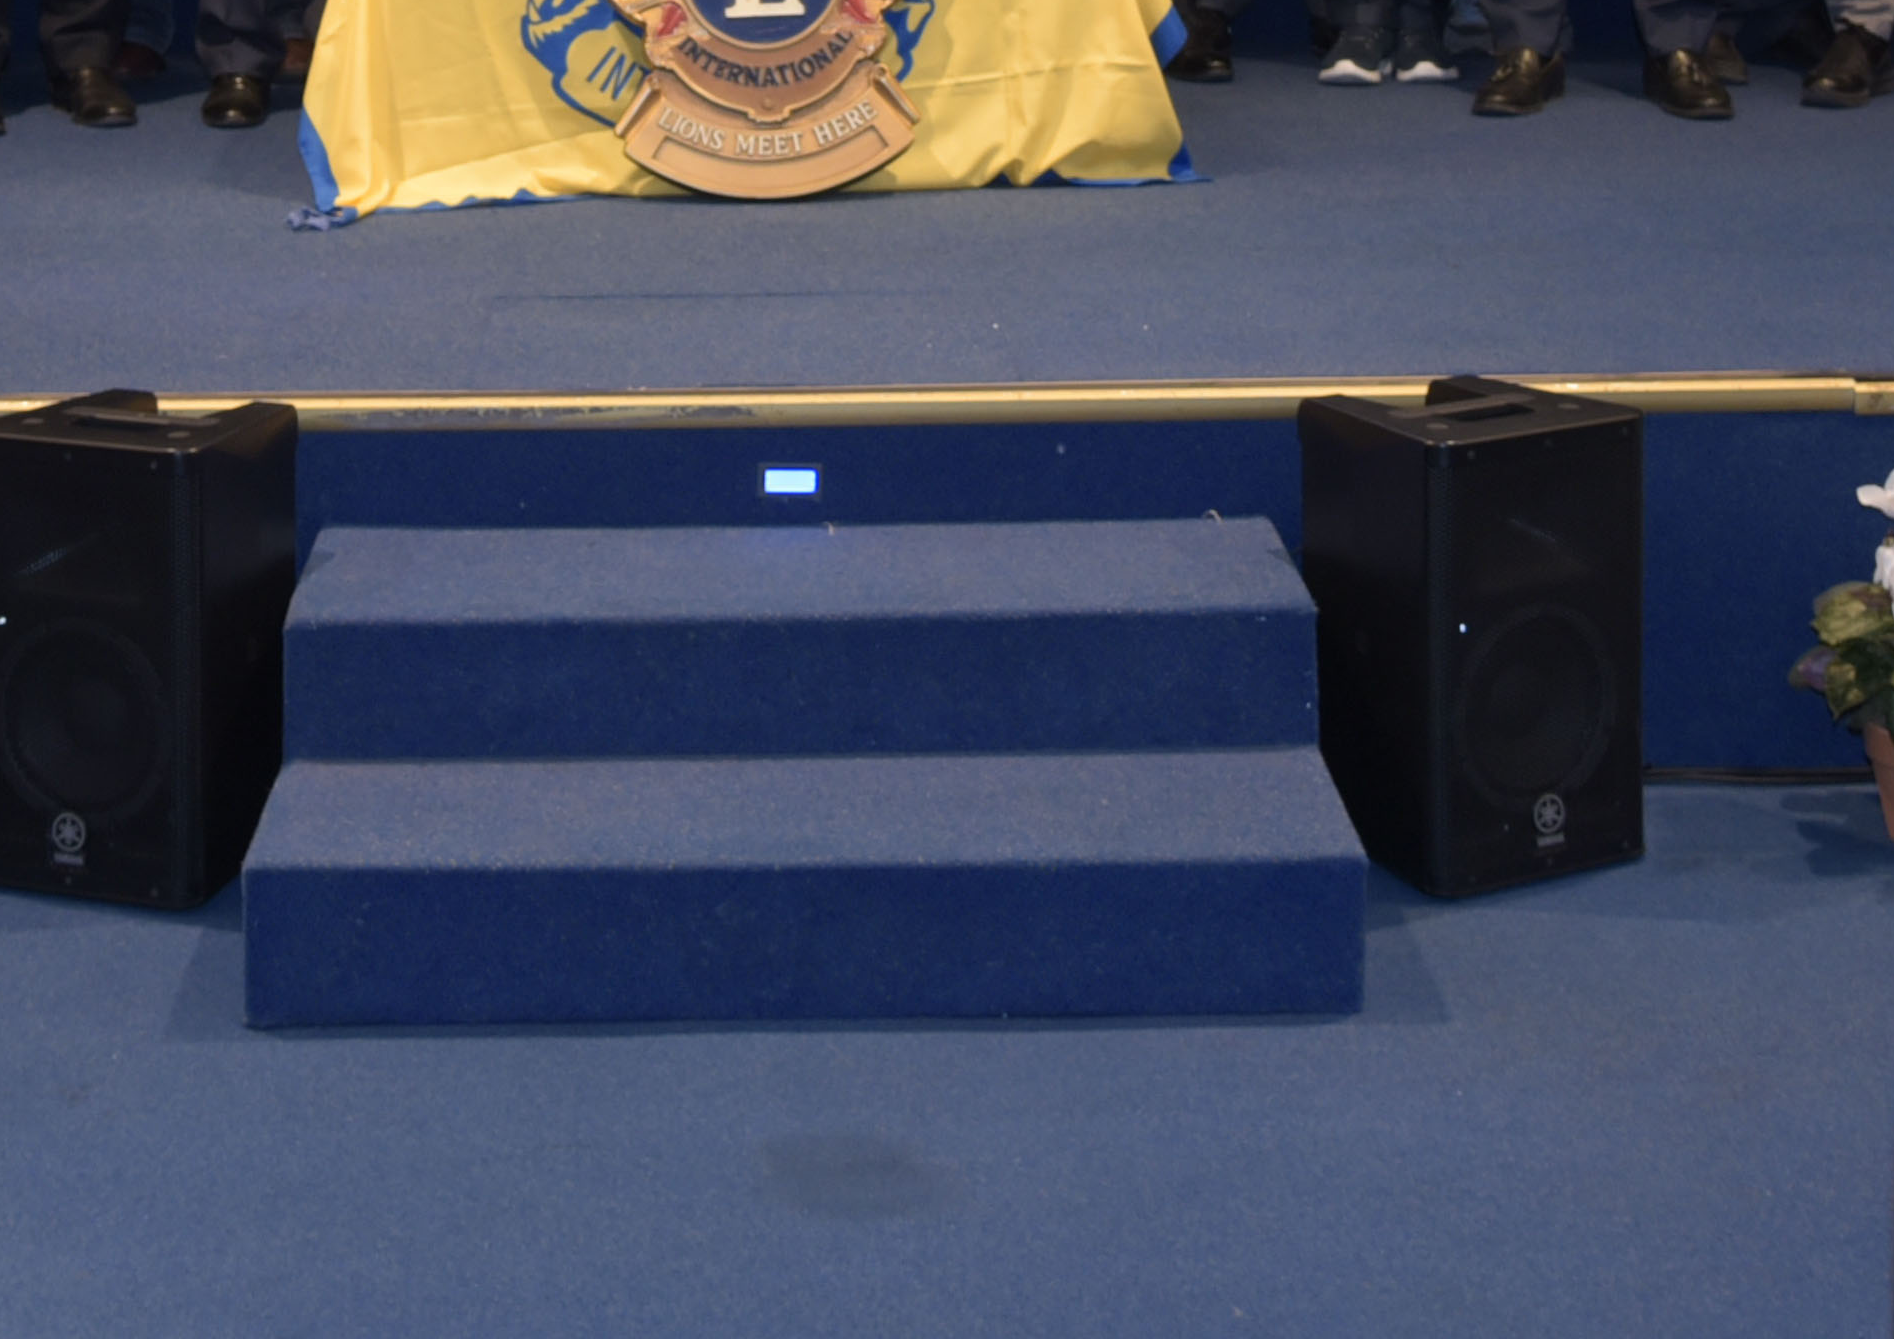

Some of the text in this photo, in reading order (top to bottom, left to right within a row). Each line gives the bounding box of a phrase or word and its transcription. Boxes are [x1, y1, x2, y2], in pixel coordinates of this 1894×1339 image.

[677, 30, 854, 88] INTERNATIONAL
[658, 98, 879, 156] LIONS MEET HERE
